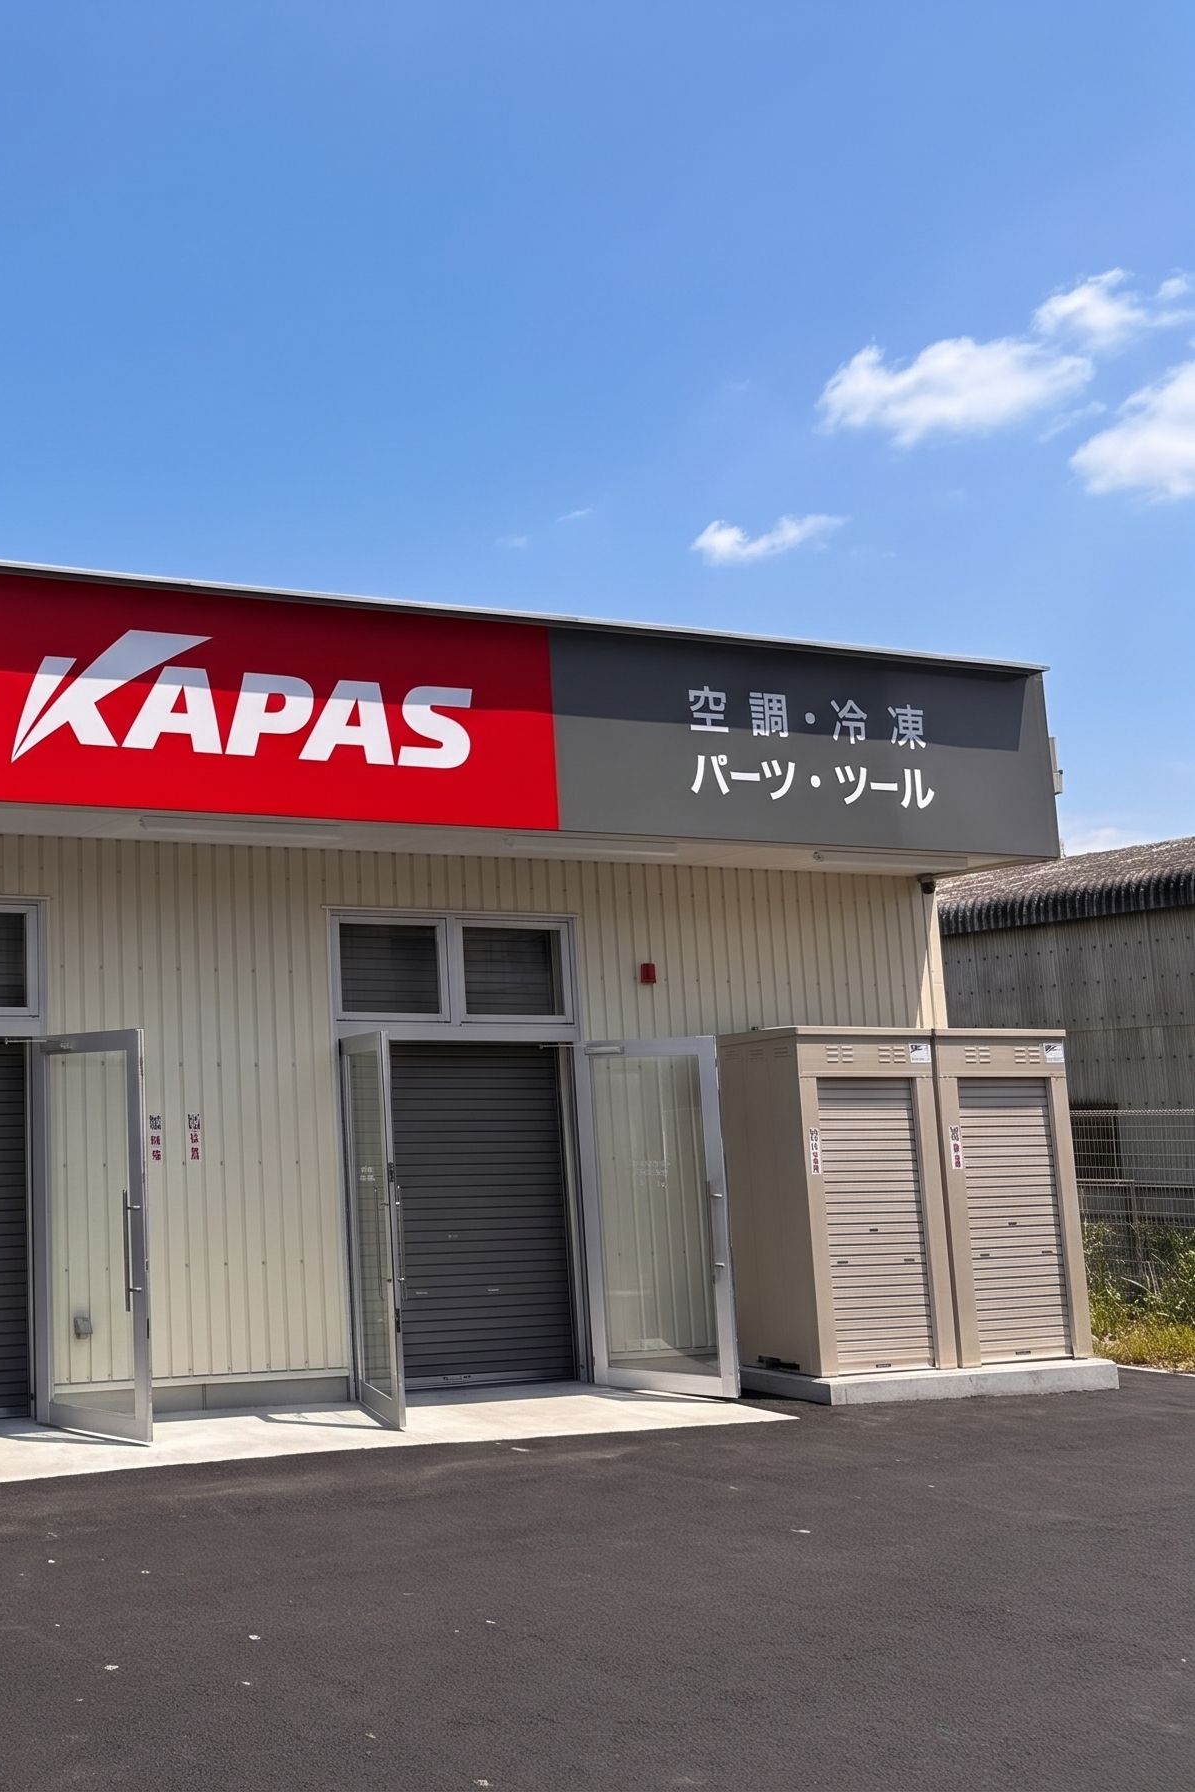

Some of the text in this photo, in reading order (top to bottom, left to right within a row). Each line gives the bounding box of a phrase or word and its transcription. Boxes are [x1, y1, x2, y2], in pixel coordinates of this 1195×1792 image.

[11, 629, 472, 768] KAPAS
[688, 685, 927, 750] 空調・冷凍
[690, 754, 935, 809] パーツ・ツール
